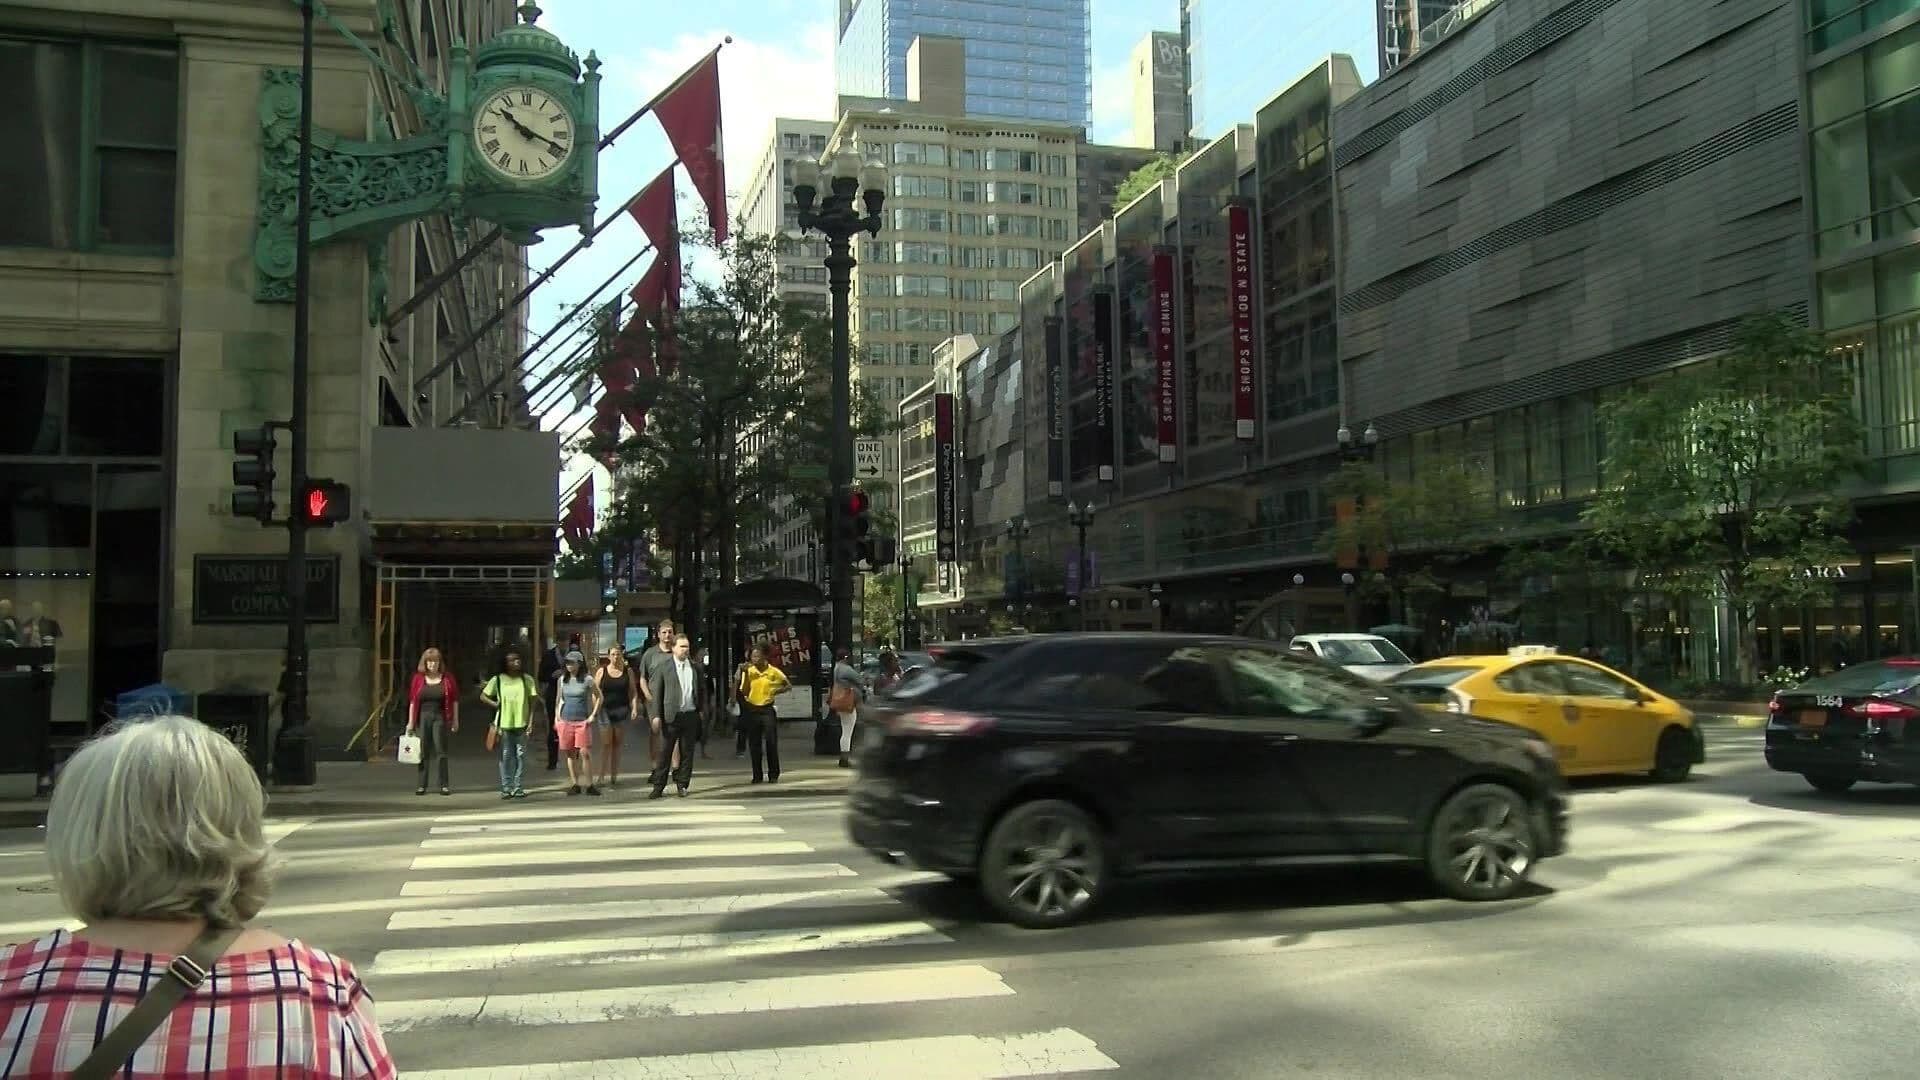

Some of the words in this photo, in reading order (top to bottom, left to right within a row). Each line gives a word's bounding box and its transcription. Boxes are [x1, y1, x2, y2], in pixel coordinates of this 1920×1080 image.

[1235, 232, 1247, 273] STATE
[1237, 279, 1248, 288] N
[1160, 292, 1171, 334] DINING
[1239, 328, 1250, 342] AT
[1240, 349, 1252, 392] SHOPS
[1161, 361, 1173, 422] SHOPPING
[857, 443, 881, 452] ONE
[857, 453, 881, 463] WAY
[207, 563, 281, 583] MARSHALL
[231, 594, 289, 614] COMPAN
